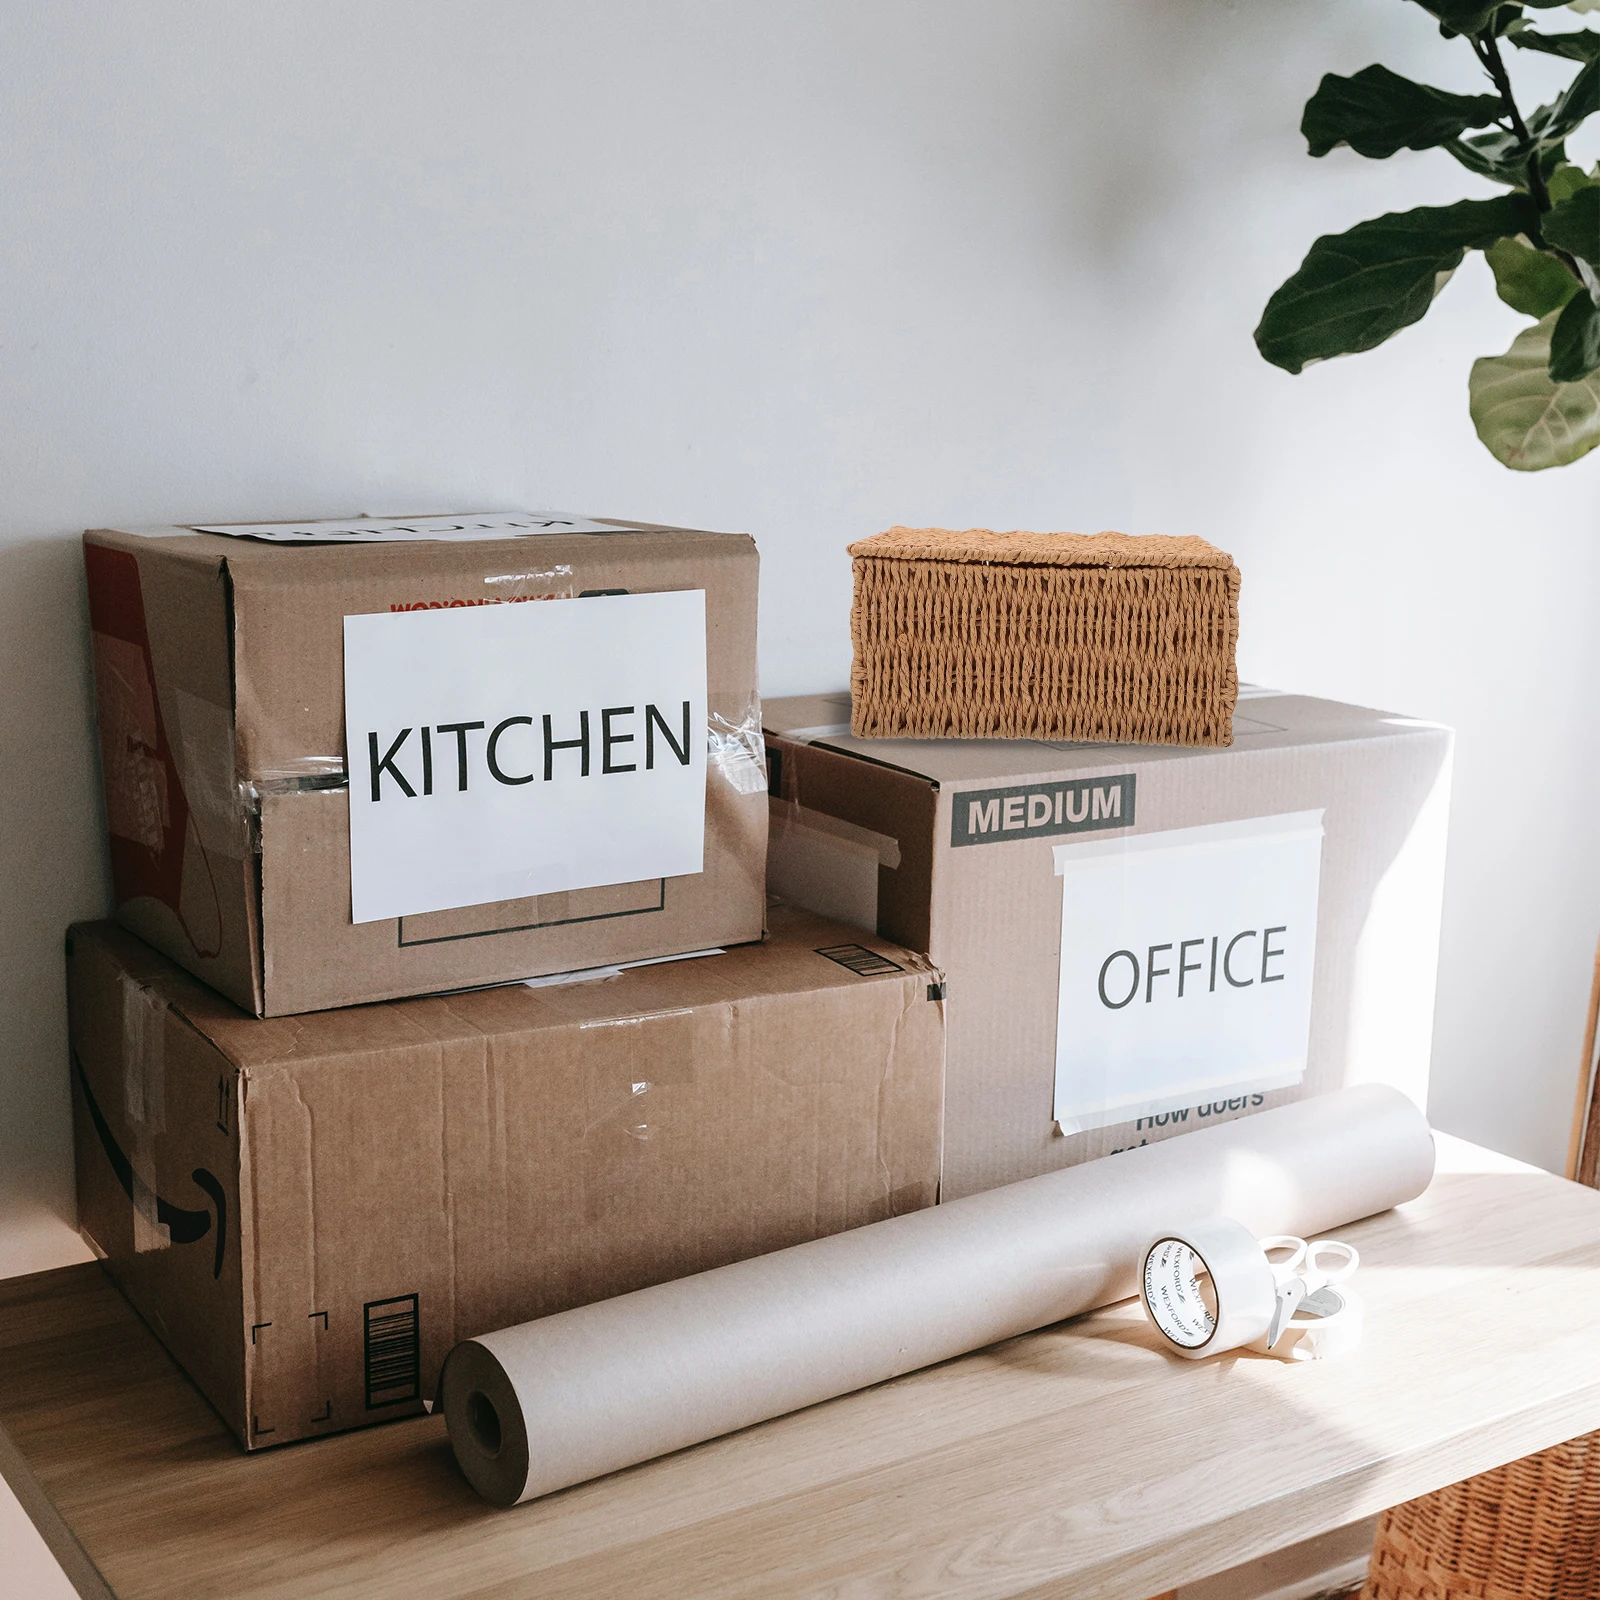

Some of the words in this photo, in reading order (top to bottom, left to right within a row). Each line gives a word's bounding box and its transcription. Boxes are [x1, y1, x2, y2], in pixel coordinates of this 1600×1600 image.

[368, 700, 691, 803] KITCHEN
[967, 785, 1122, 835] MEDIUM
[1098, 925, 1287, 1010] OFFICE
[1160, 1285, 1187, 1331] WEXFORD
